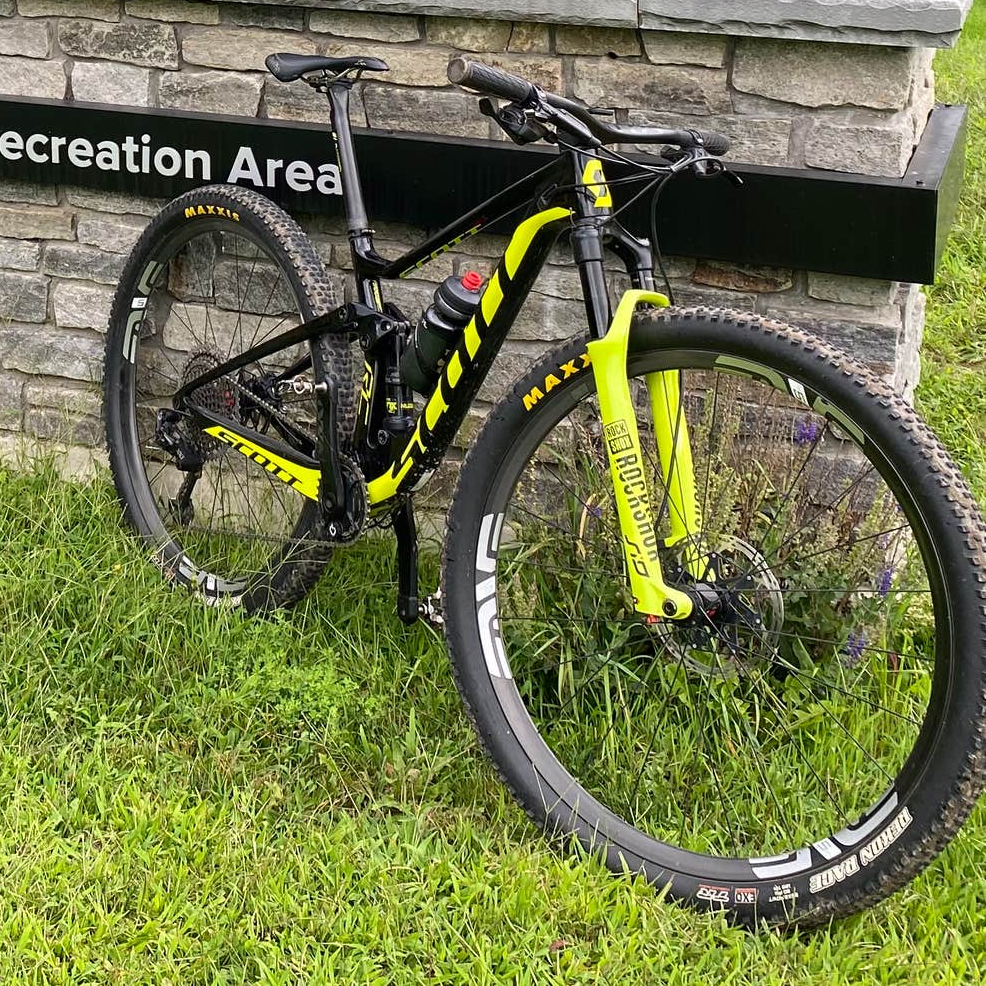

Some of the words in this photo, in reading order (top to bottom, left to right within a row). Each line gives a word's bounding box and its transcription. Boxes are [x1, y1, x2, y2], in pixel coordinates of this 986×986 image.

[226, 146, 344, 196] Area
[184, 205, 240, 222] MAXXIS
[522, 353, 591, 412] MAXX
[809, 854, 860, 894] RACE
